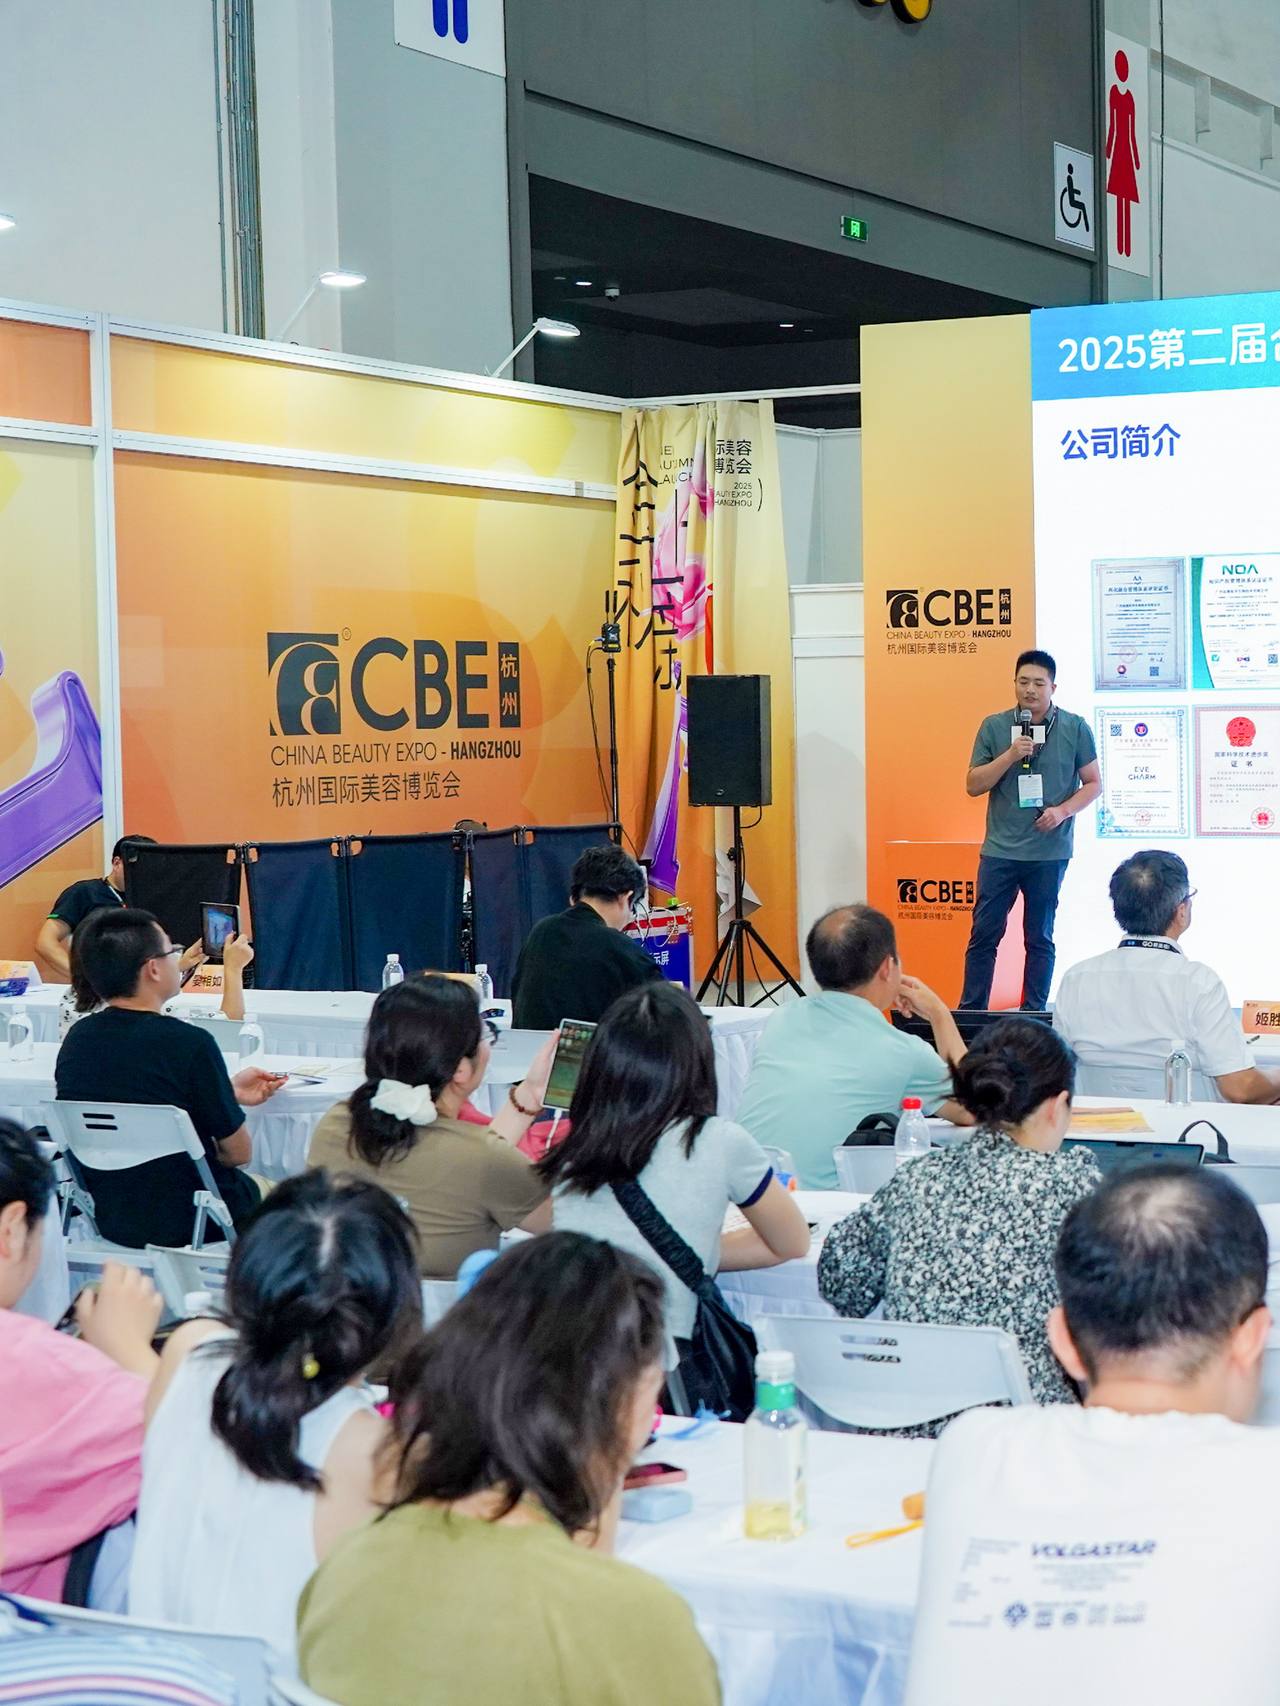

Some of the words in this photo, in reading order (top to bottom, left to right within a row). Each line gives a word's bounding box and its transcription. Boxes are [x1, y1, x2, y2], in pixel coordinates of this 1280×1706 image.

[1060, 423, 1182, 460] 公司简介
[734, 482, 753, 490] 2025
[923, 588, 994, 626] CBE
[1000, 592, 1010, 620] 杭州
[886, 630, 913, 640] CHINA
[914, 630, 943, 639] BEAUTY
[944, 630, 966, 639] EXPO
[972, 629, 1012, 638] HANGZHOU
[887, 641, 978, 655] 杭州国际美容博览会
[350, 636, 490, 732] CBE
[500, 653, 518, 717] 杭州
[270, 744, 327, 766] CHINA
[332, 743, 391, 765] BEAUTY
[396, 741, 437, 762] EXPO
[450, 739, 521, 760] HANGZHOU
[271, 770, 461, 808] 杭州国际美容博览会
[920, 880, 963, 904] CBE
